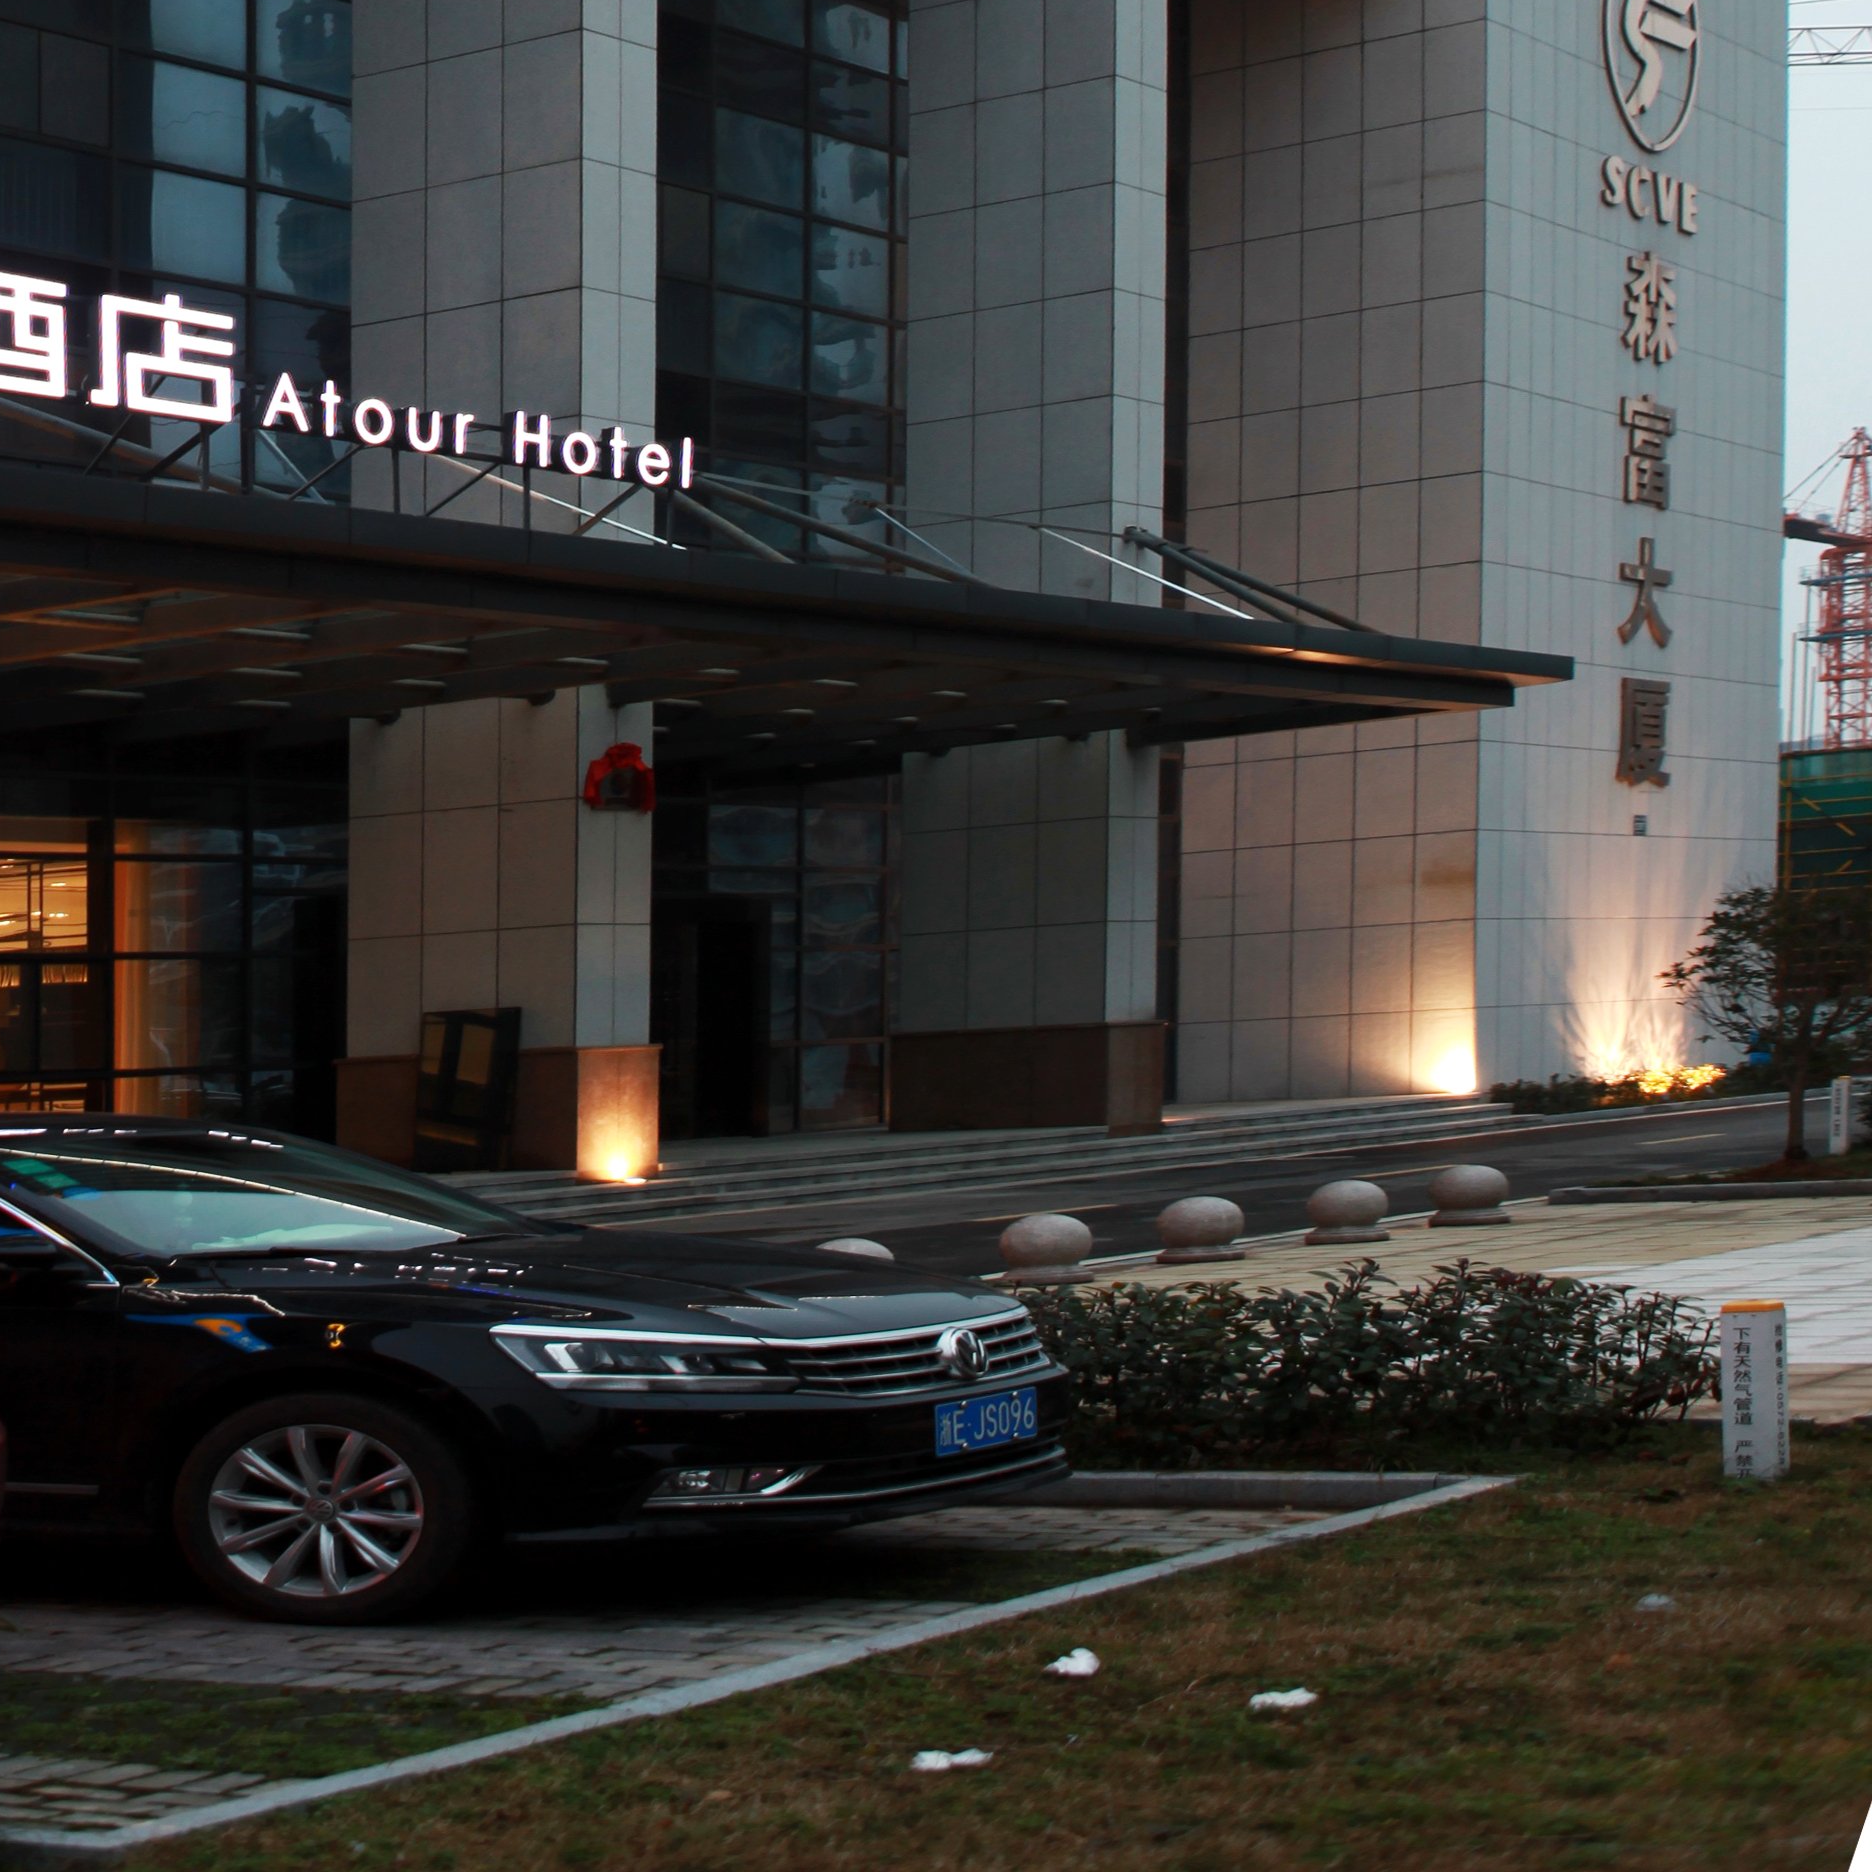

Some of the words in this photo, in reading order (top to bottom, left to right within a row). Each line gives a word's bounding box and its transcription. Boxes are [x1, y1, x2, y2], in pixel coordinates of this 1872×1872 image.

[1601, 155, 1697, 236] SCVE
[262, 372, 474, 455] Atour
[514, 410, 693, 489] Hotel
[1616, 251, 1677, 789] 森富大厦
[1732, 1326, 1753, 1426] 下有天然气管道
